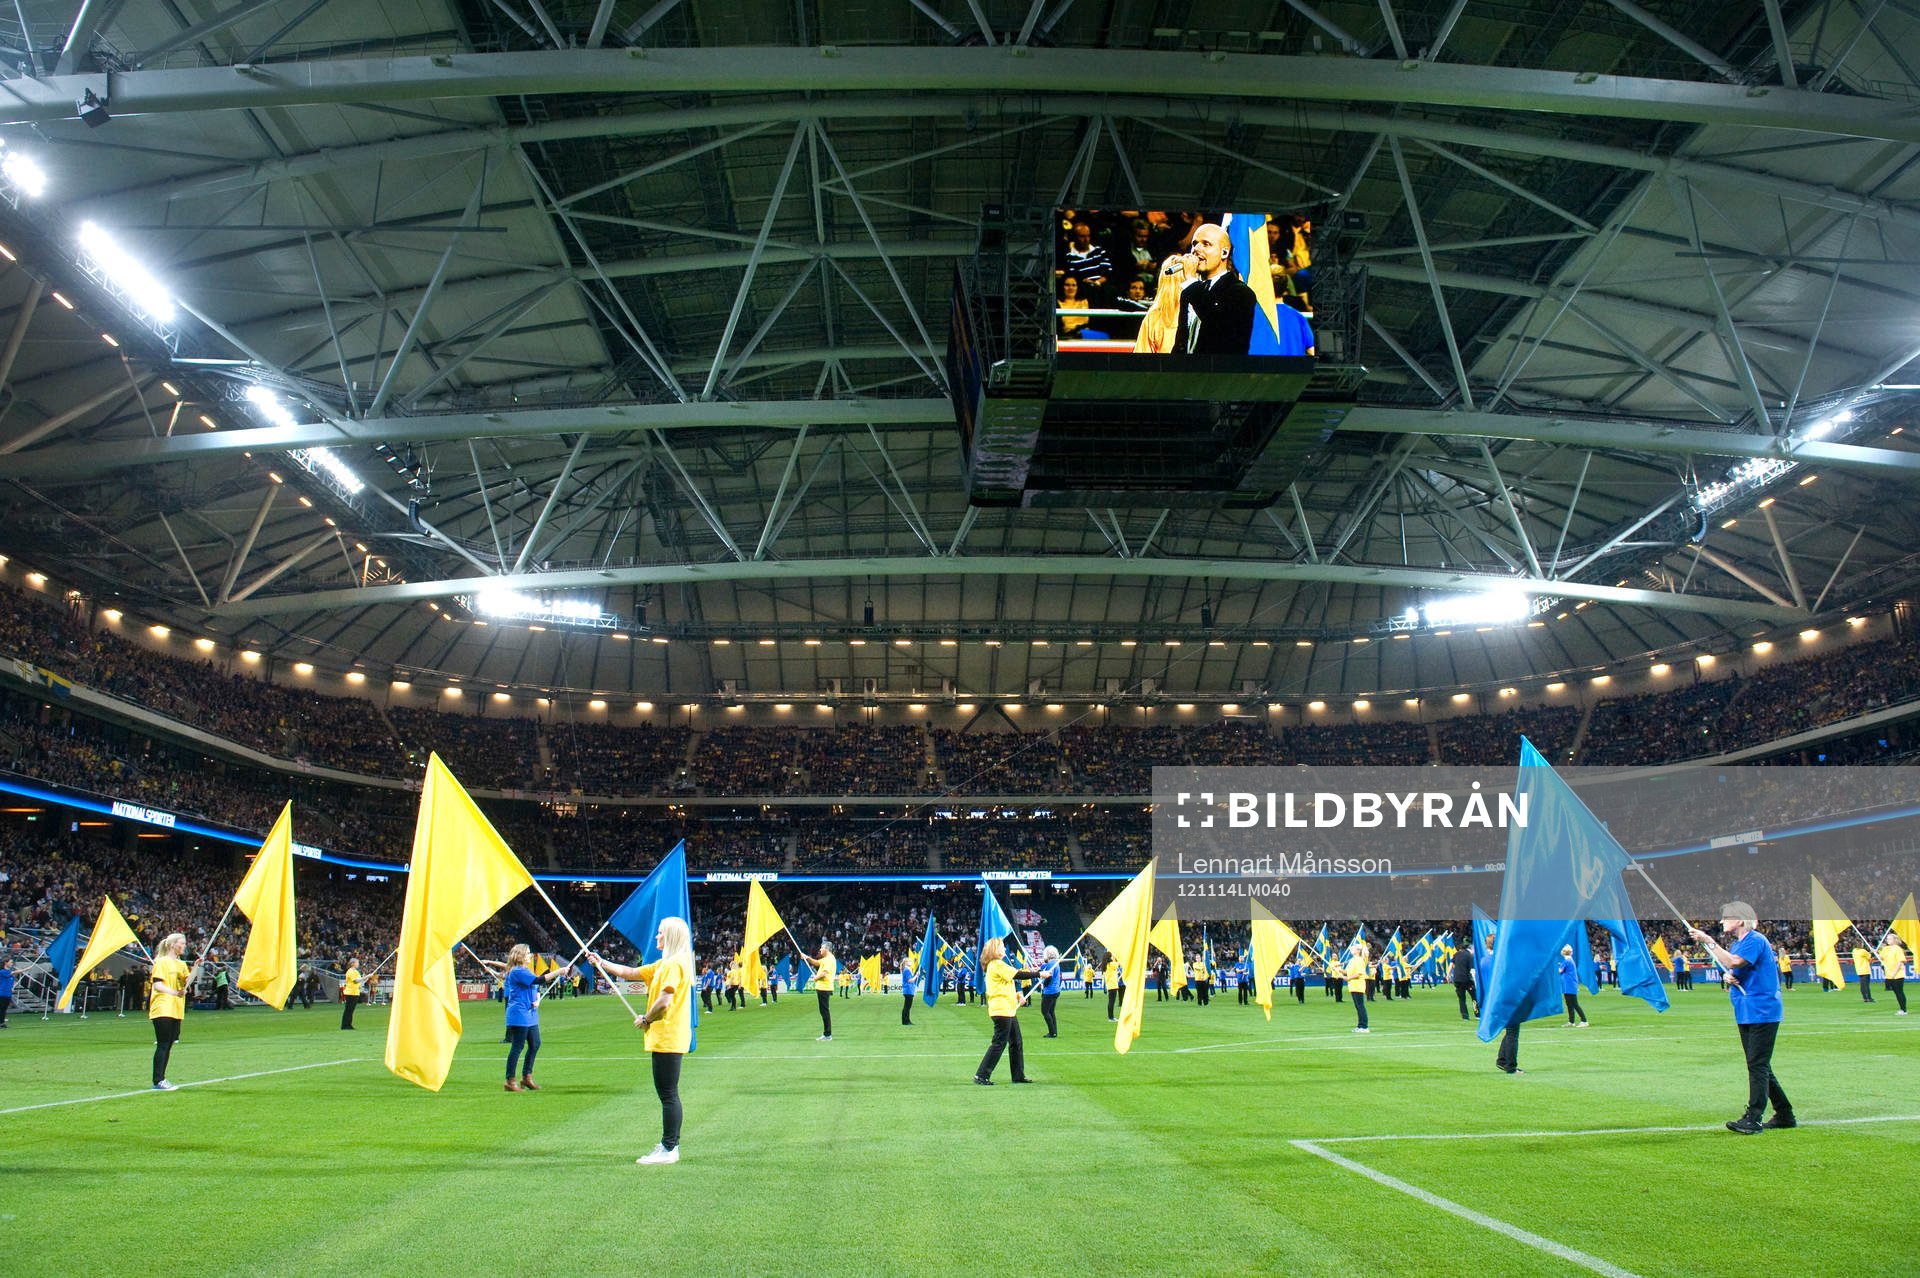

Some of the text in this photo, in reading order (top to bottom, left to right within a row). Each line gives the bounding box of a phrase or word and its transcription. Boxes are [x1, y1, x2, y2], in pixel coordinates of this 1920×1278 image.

[112, 801, 176, 827] NATIONALSPORTEN
[706, 872, 778, 881] NATIONALSPORTEN
[982, 871, 1051, 880] NATIONALSPORTEN
